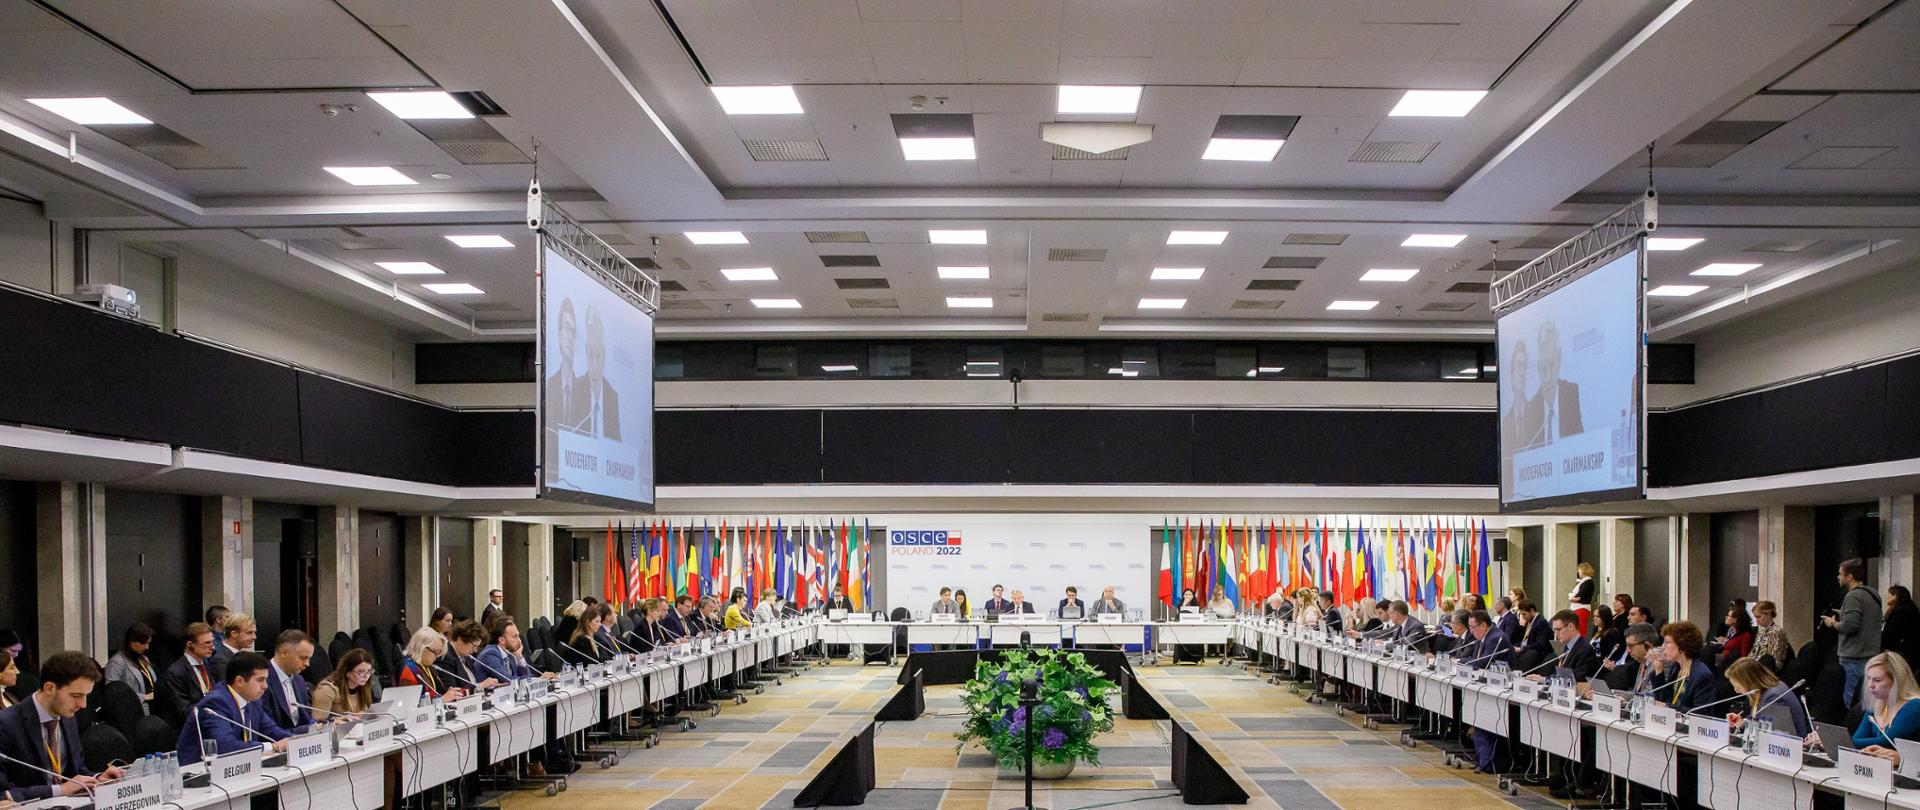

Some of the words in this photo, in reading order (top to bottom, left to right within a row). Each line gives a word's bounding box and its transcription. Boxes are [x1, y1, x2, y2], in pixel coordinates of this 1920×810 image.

[565, 450, 597, 472] MODERATOR
[1520, 461, 1552, 480] MODERATOR
[1563, 452, 1604, 474] CHAIRMANSHIP
[892, 547, 933, 555] POLAND
[936, 547, 961, 555] 2022
[1651, 714, 1667, 725] FRANCE
[1697, 727, 1719, 739] FINLAND
[299, 744, 322, 758] BELARUS
[1768, 744, 1791, 758] ESTONIA
[224, 762, 251, 778] BELGIUM
[1854, 764, 1873, 779] SPAIN
[117, 784, 142, 799] BOSNIA
[114, 795, 160, 810] HERZEGOVINA
